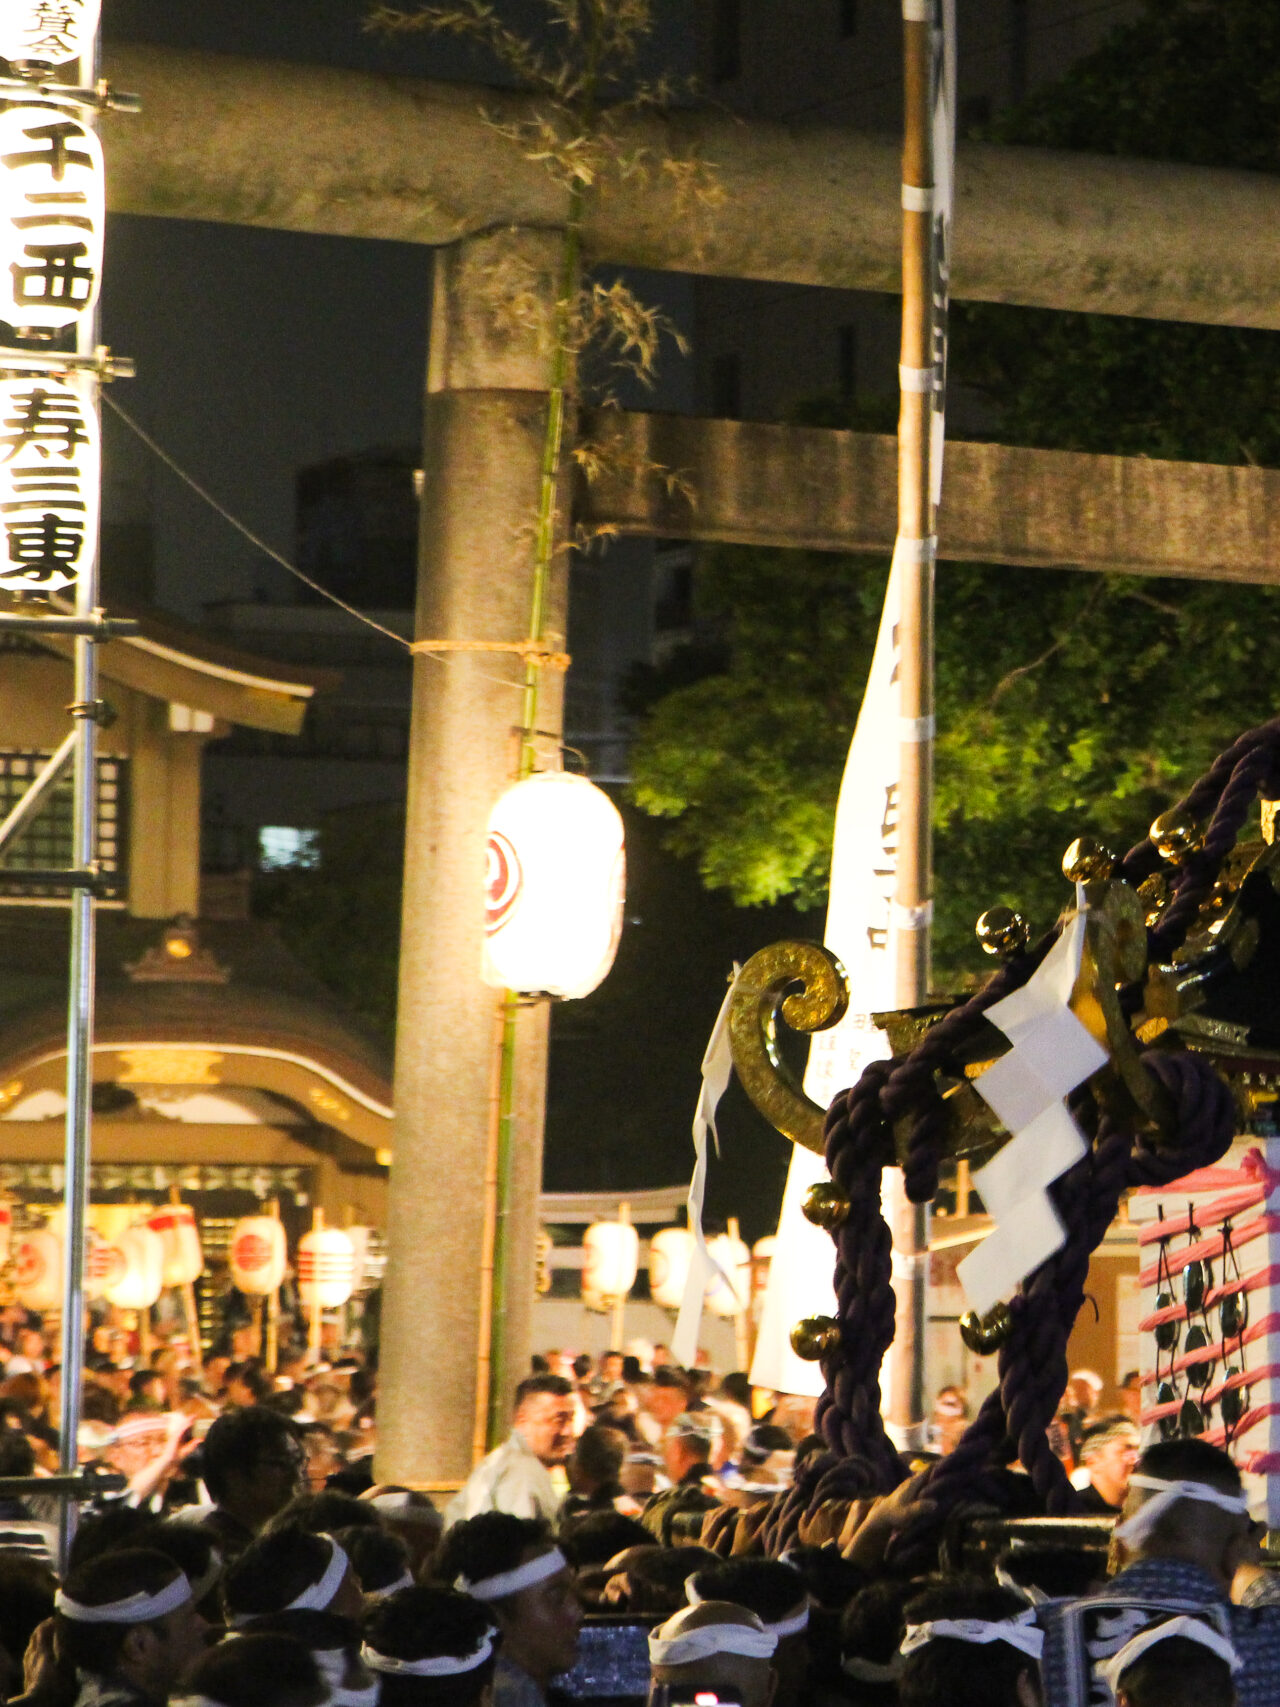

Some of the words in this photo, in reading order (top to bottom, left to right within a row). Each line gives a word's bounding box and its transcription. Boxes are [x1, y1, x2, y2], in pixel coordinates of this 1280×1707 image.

[18, 0, 84, 56] 賛会
[1, 121, 95, 312] 千二西
[0, 388, 90, 582] 寿三東
